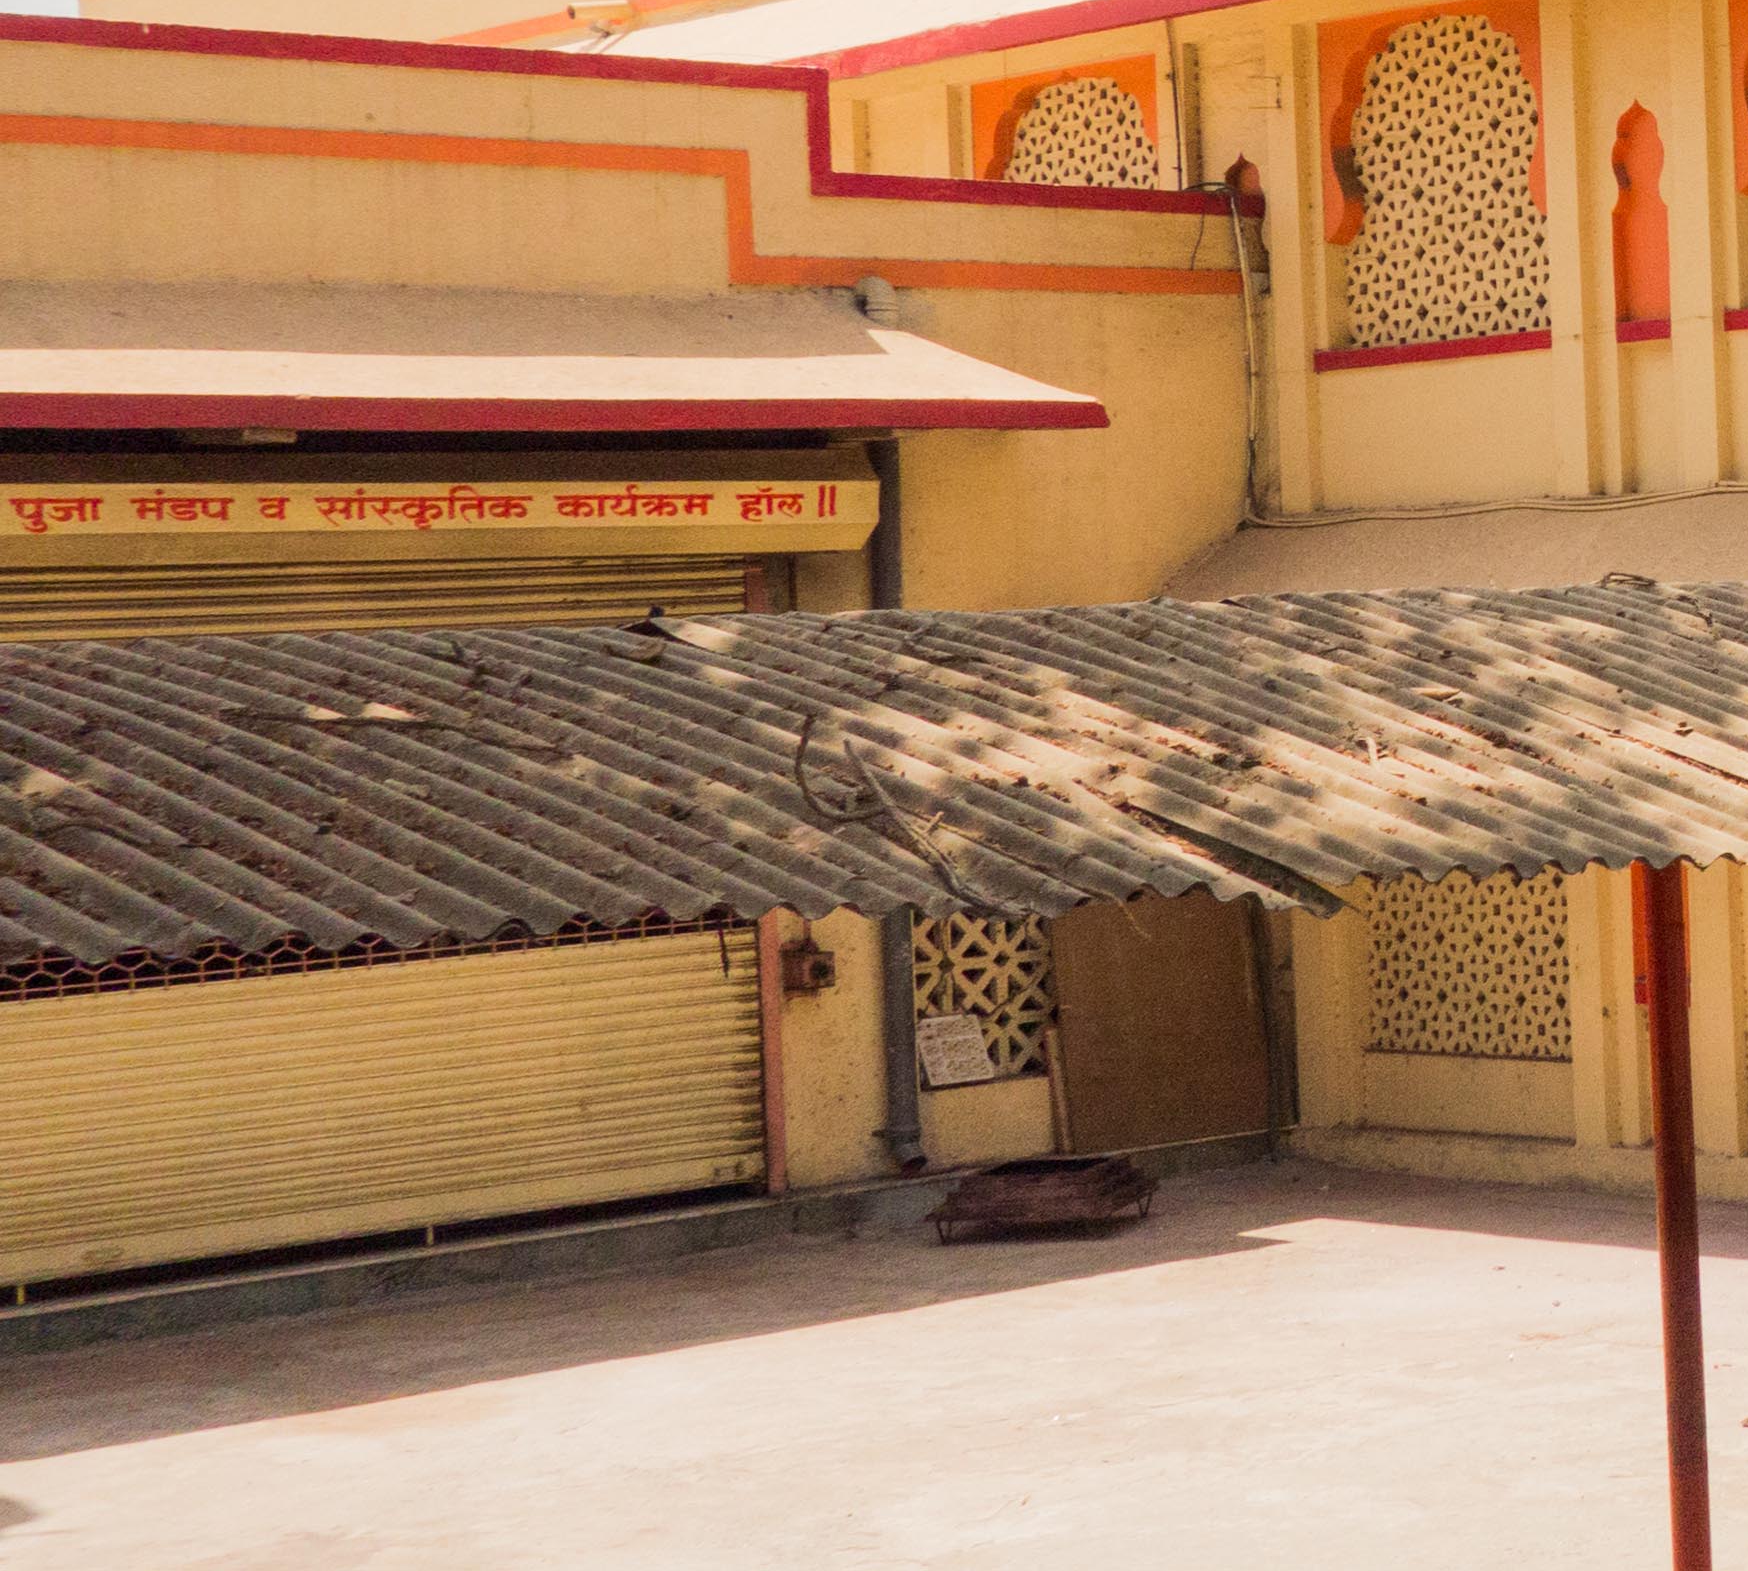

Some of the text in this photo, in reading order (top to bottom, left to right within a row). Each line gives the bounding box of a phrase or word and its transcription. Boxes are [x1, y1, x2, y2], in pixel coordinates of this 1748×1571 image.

[8, 495, 103, 533] पुजा
[131, 490, 235, 523] मंडप
[258, 496, 289, 522] व
[314, 485, 534, 530] सांस्कृतिक
[554, 484, 714, 520] कार्यक्रम
[735, 487, 804, 523] हॉल
